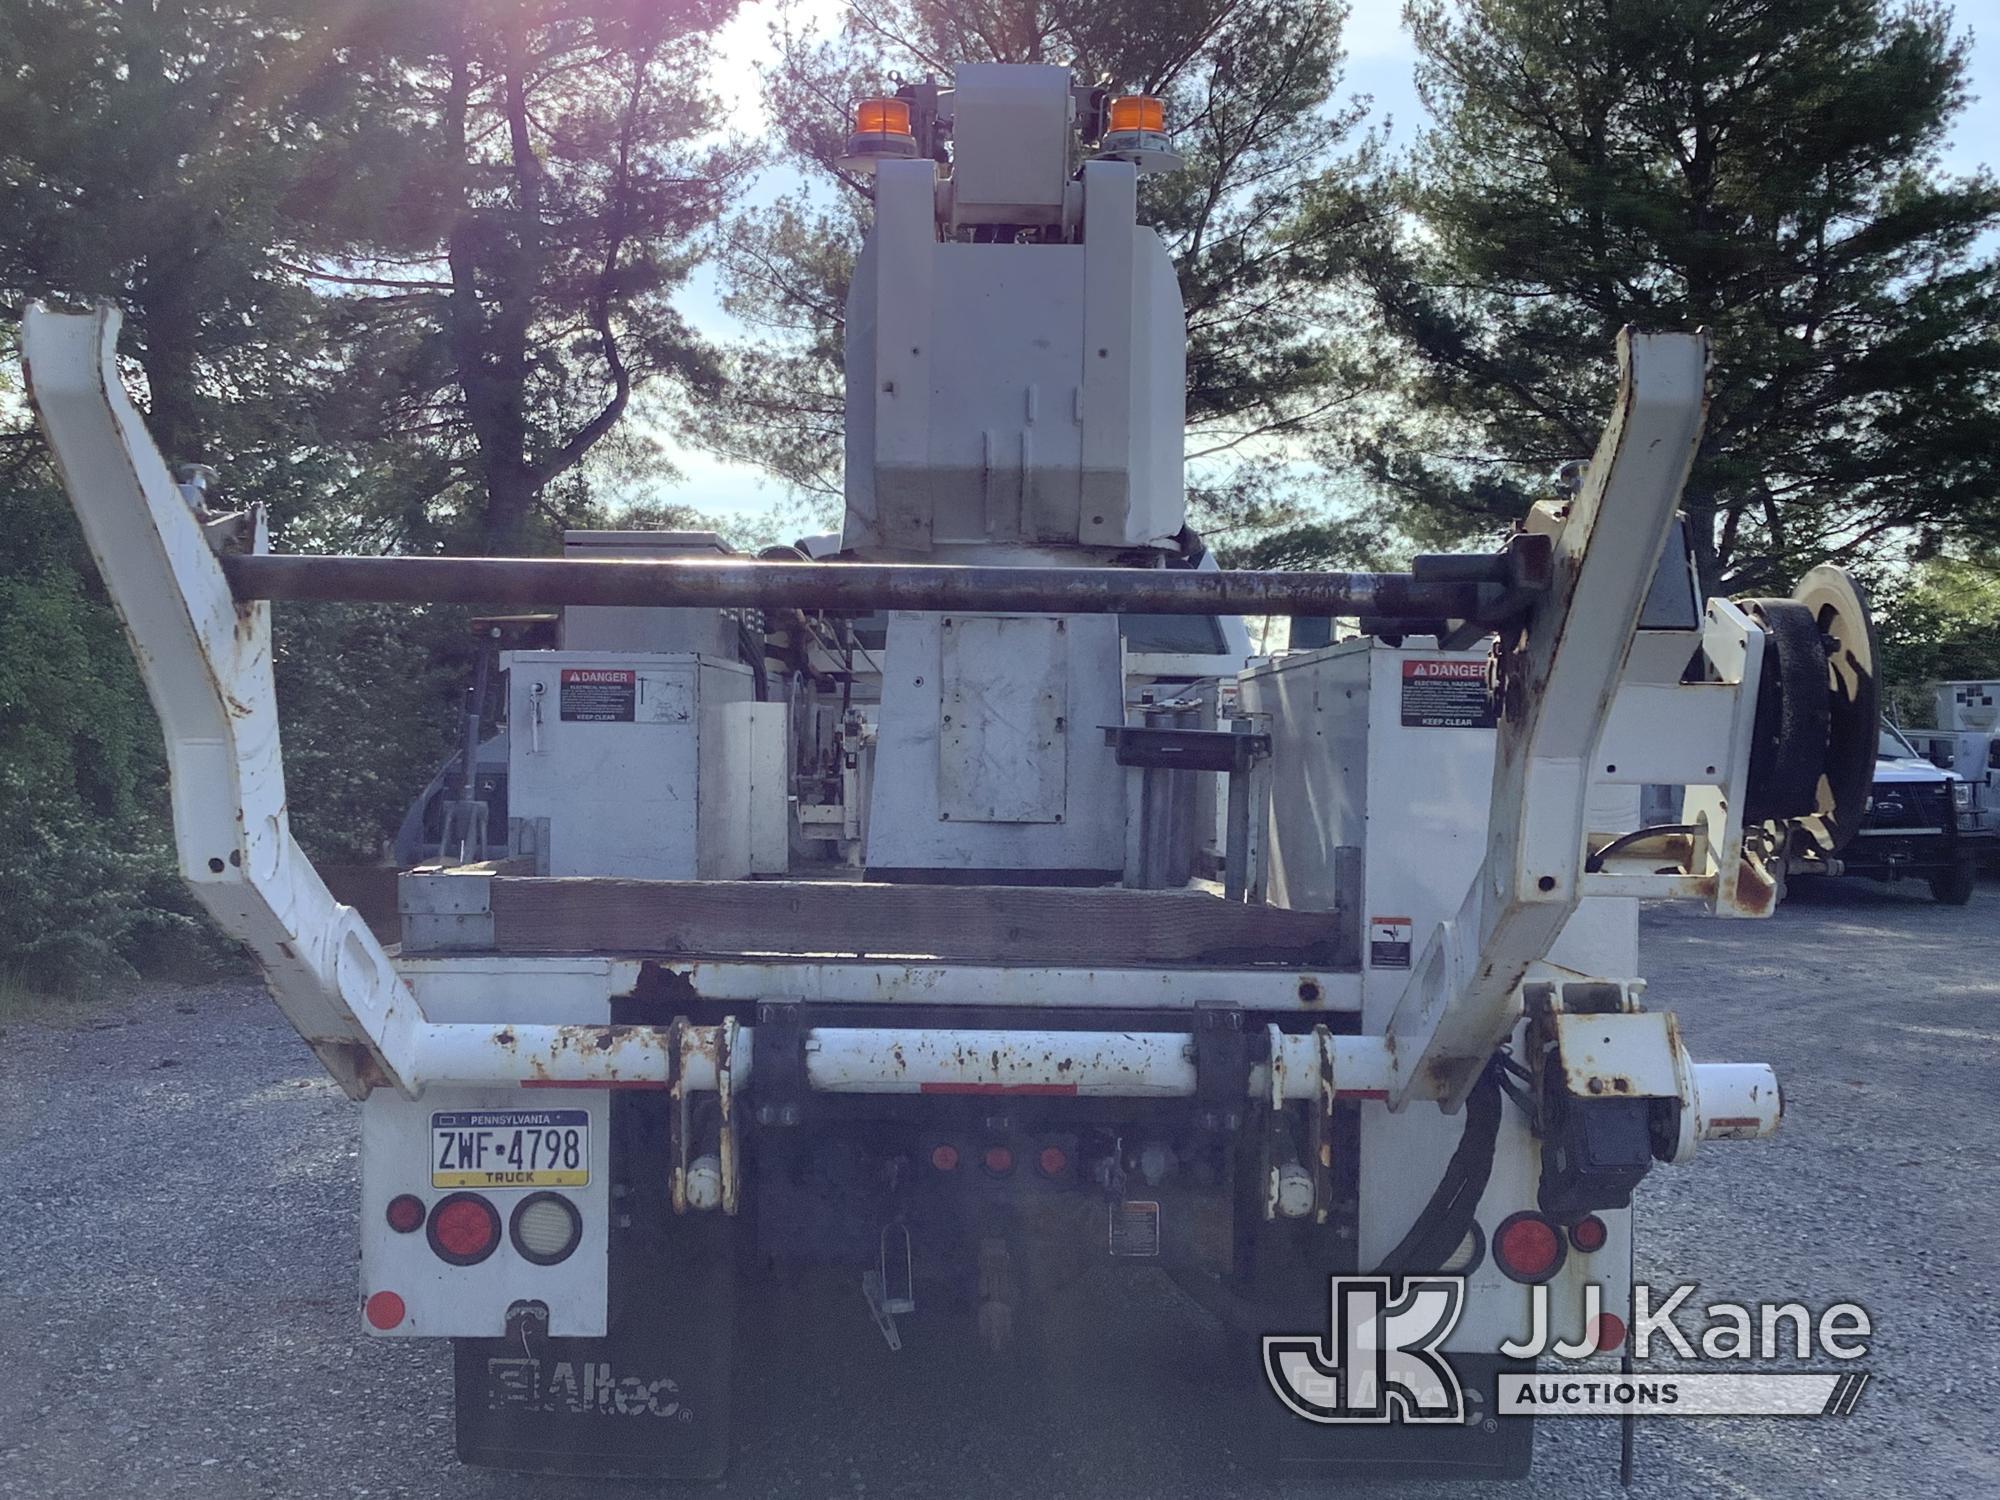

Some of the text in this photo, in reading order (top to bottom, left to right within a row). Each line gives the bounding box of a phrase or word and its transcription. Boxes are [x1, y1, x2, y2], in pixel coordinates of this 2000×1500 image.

[1429, 664, 1487, 677] DANGER
[582, 672, 627, 682] DANGER
[1445, 718, 1472, 726] CLEAR
[471, 1115, 550, 1125] PENNSYLVANIA
[485, 1172, 534, 1183] TRUCK
